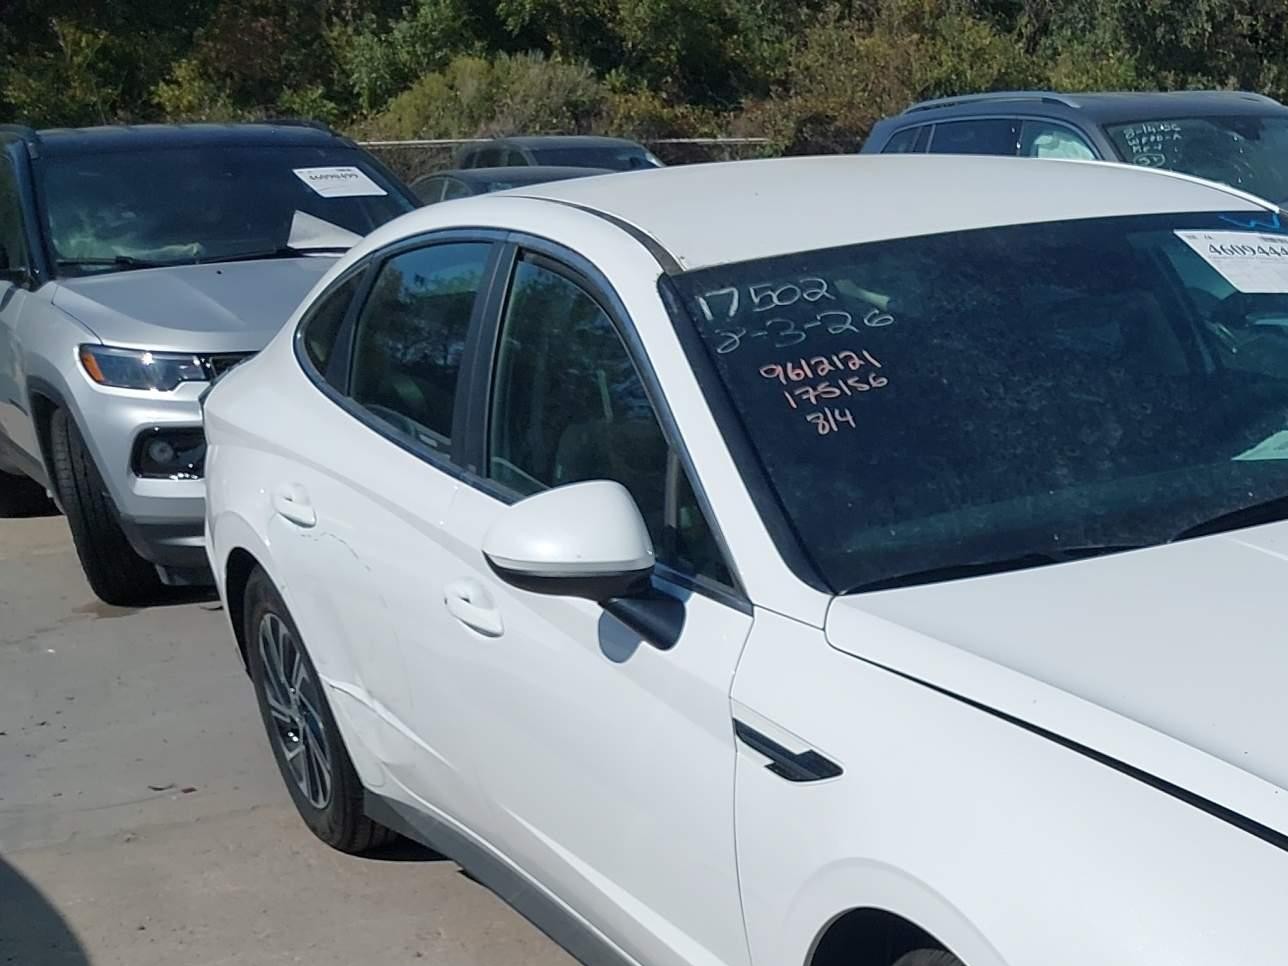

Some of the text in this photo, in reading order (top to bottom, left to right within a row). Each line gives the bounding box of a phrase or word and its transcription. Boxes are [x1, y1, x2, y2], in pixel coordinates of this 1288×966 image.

[694, 277, 837, 320] 17502
[758, 349, 882, 386] 9612121
[783, 373, 889, 409] 175156
